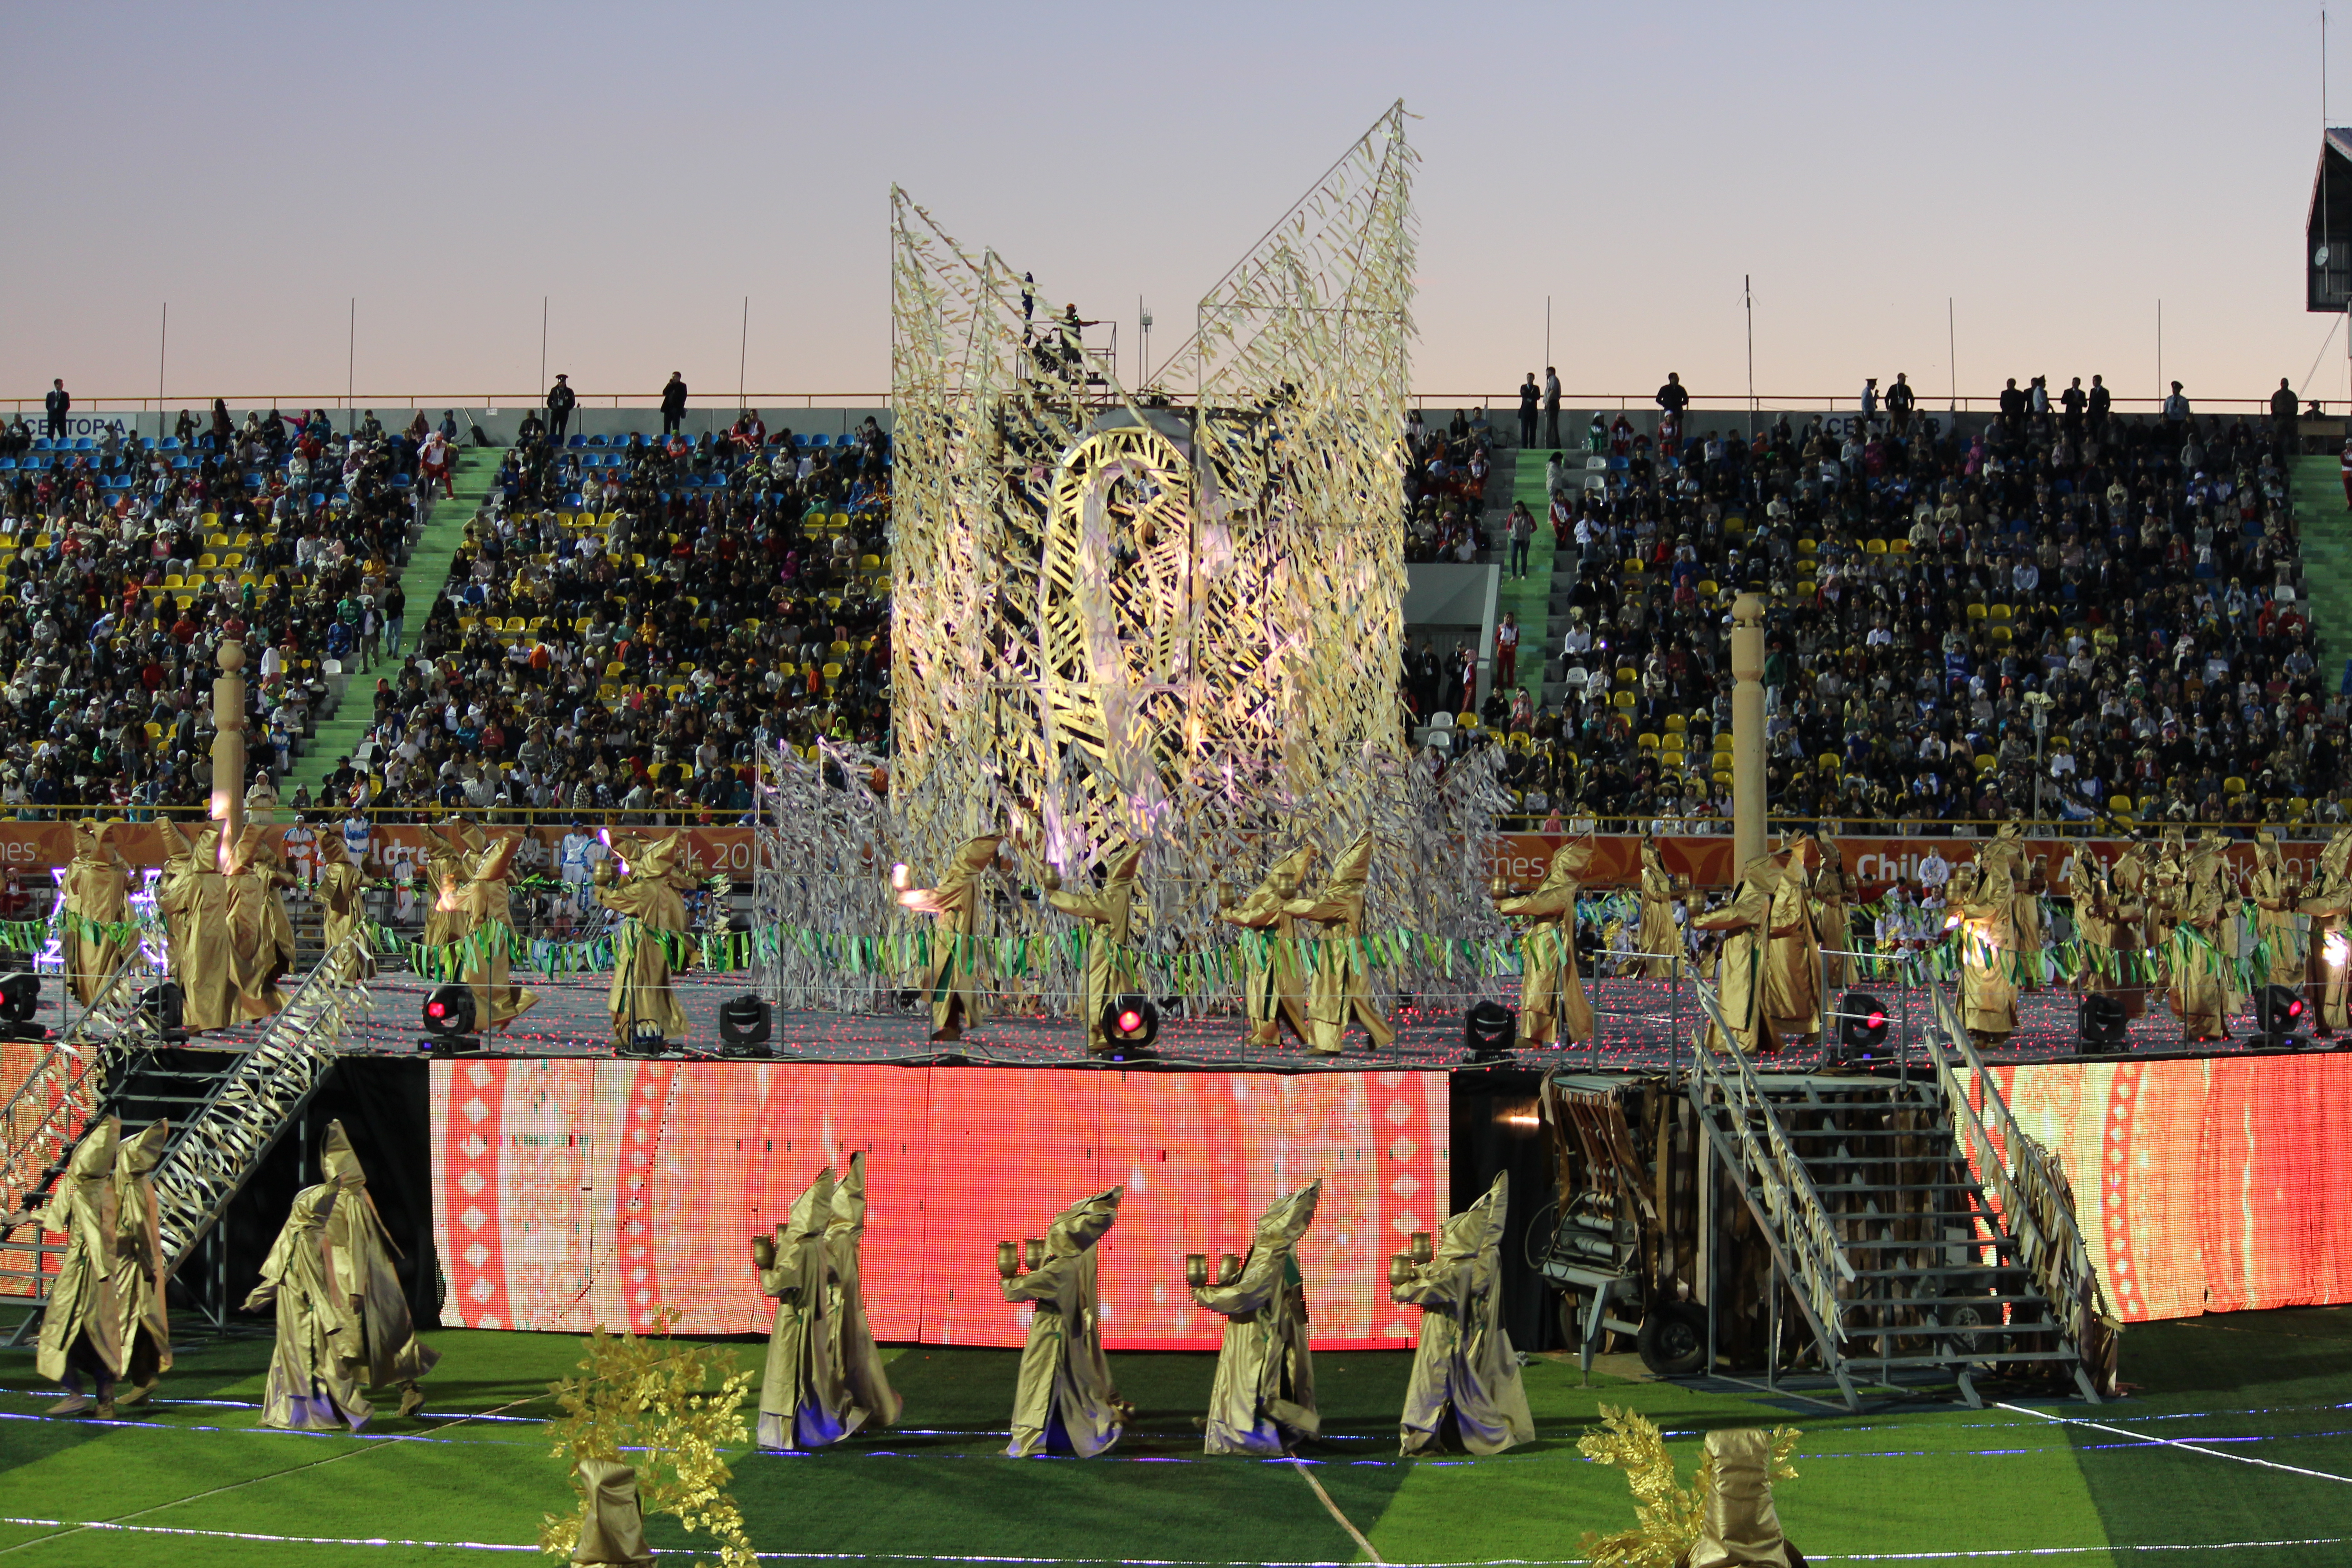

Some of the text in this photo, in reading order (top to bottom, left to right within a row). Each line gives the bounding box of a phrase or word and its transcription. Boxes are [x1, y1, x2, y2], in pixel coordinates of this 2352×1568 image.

[24, 418, 105, 435] СЕТОР
[373, 838, 430, 865] ldre
[1485, 857, 1544, 877] mes
